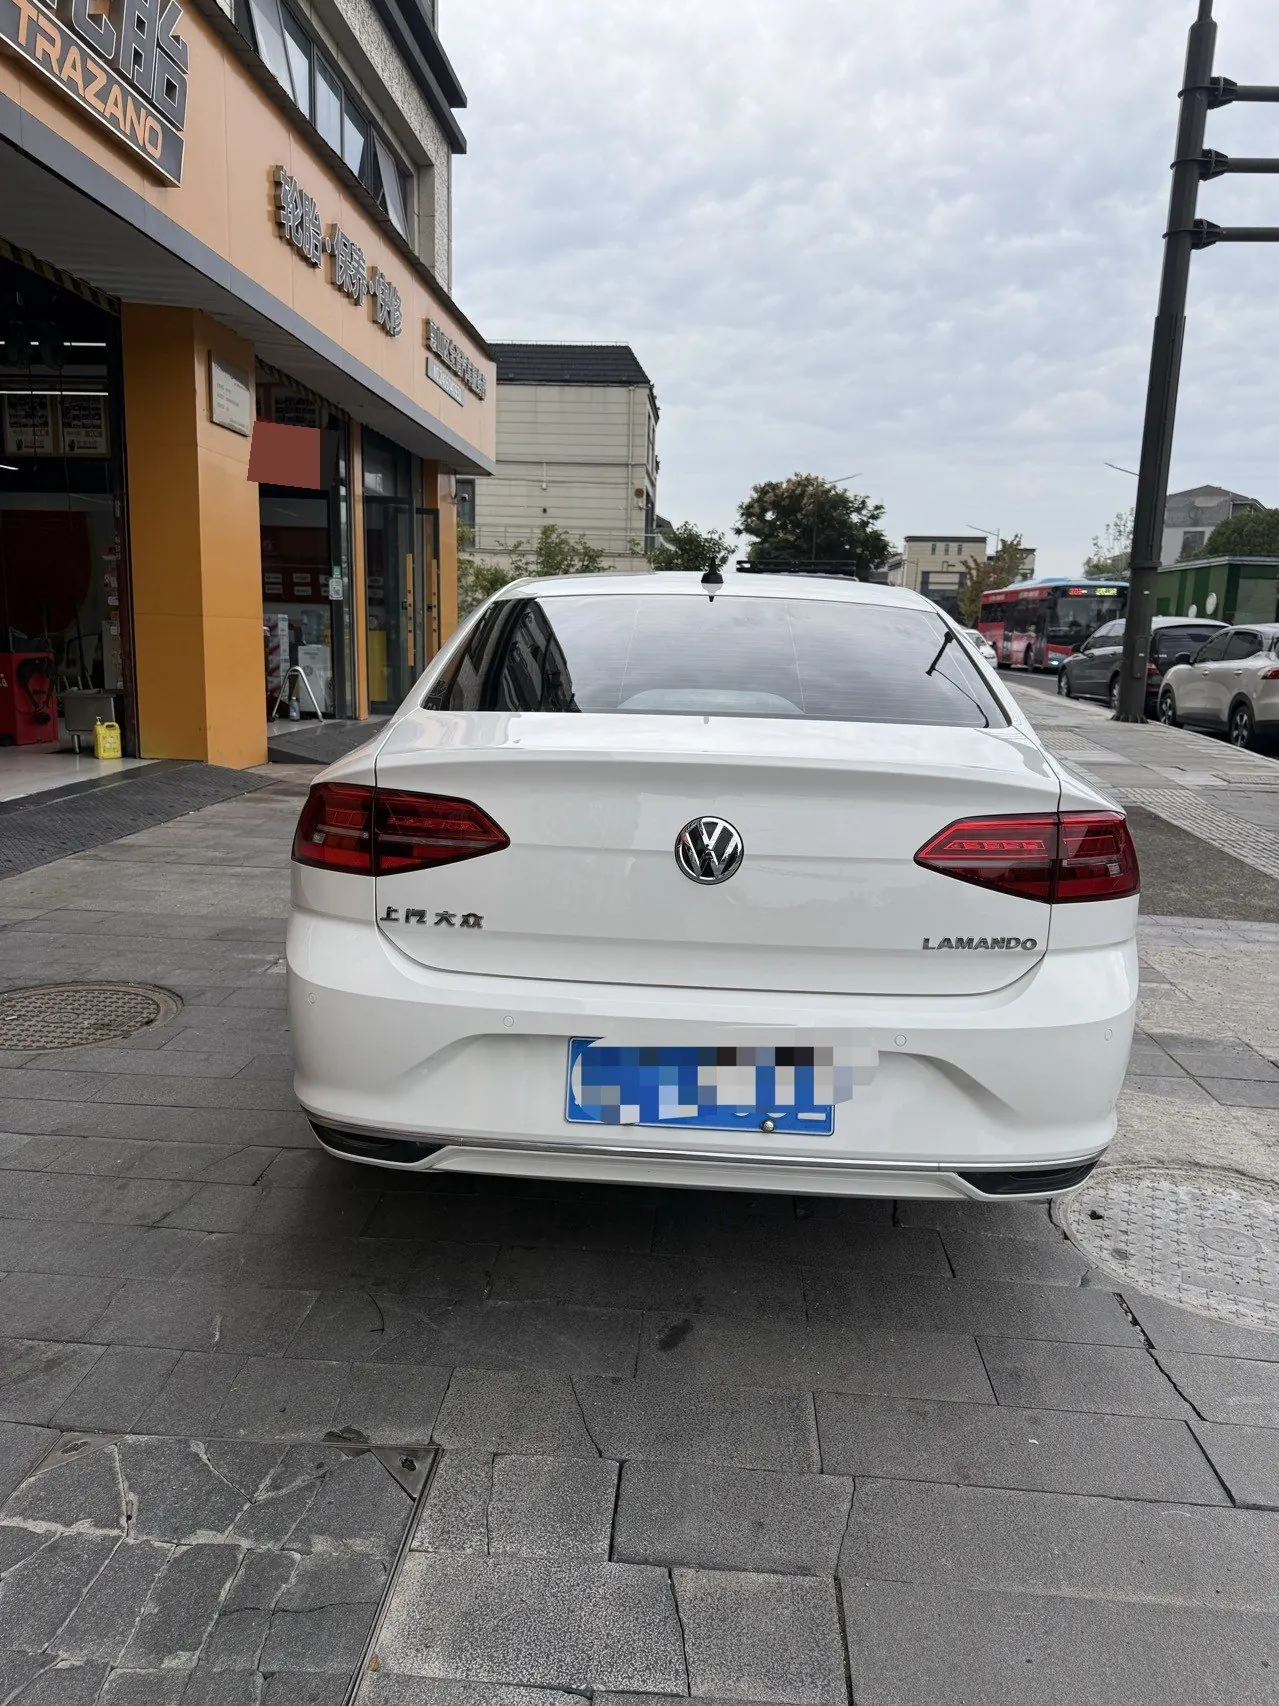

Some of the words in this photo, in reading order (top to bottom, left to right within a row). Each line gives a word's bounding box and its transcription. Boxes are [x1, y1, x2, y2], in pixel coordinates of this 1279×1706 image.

[11, 0, 163, 159] TRAZANO
[380, 906, 484, 928] 上汽大众
[922, 936, 1038, 951] LAMANDO
